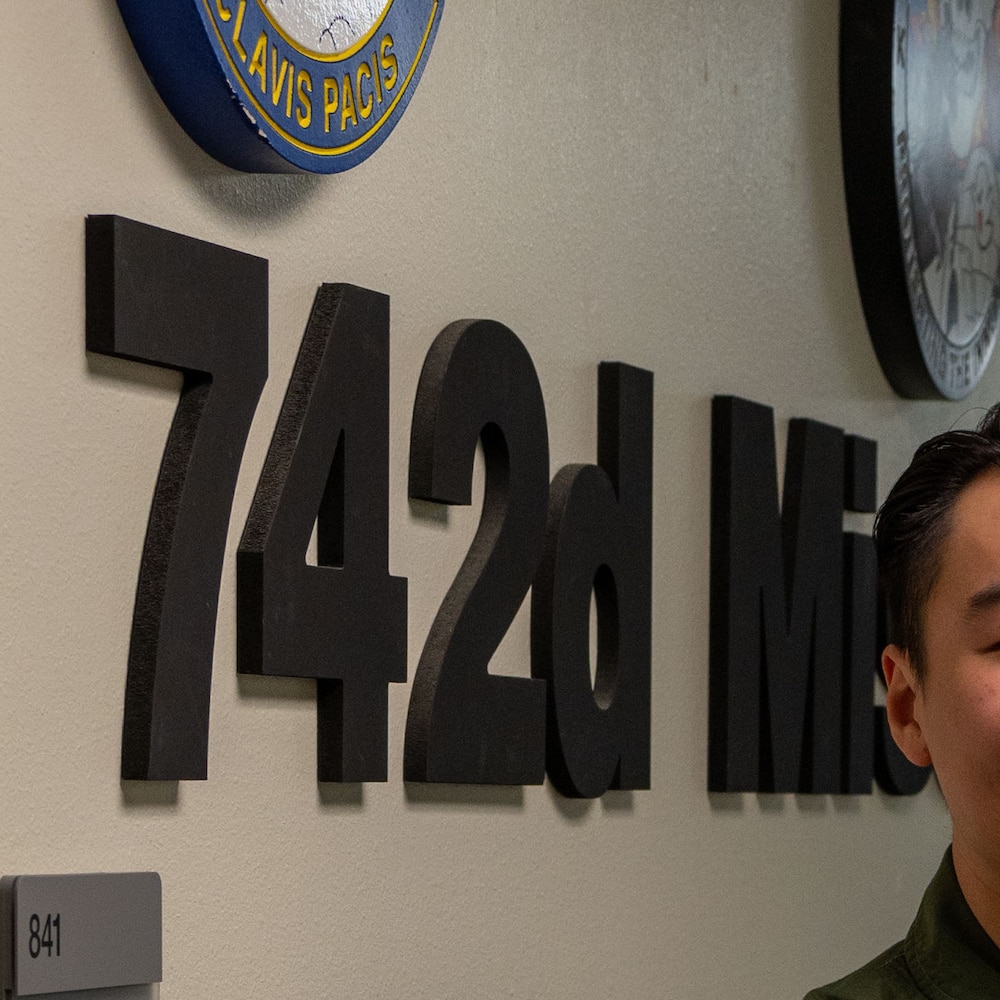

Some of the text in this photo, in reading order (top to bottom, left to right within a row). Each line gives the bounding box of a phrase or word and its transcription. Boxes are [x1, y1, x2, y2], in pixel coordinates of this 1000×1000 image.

[323, 33, 398, 133] PACIS
[85, 214, 654, 799] 742d
[28, 913, 61, 959] 841
